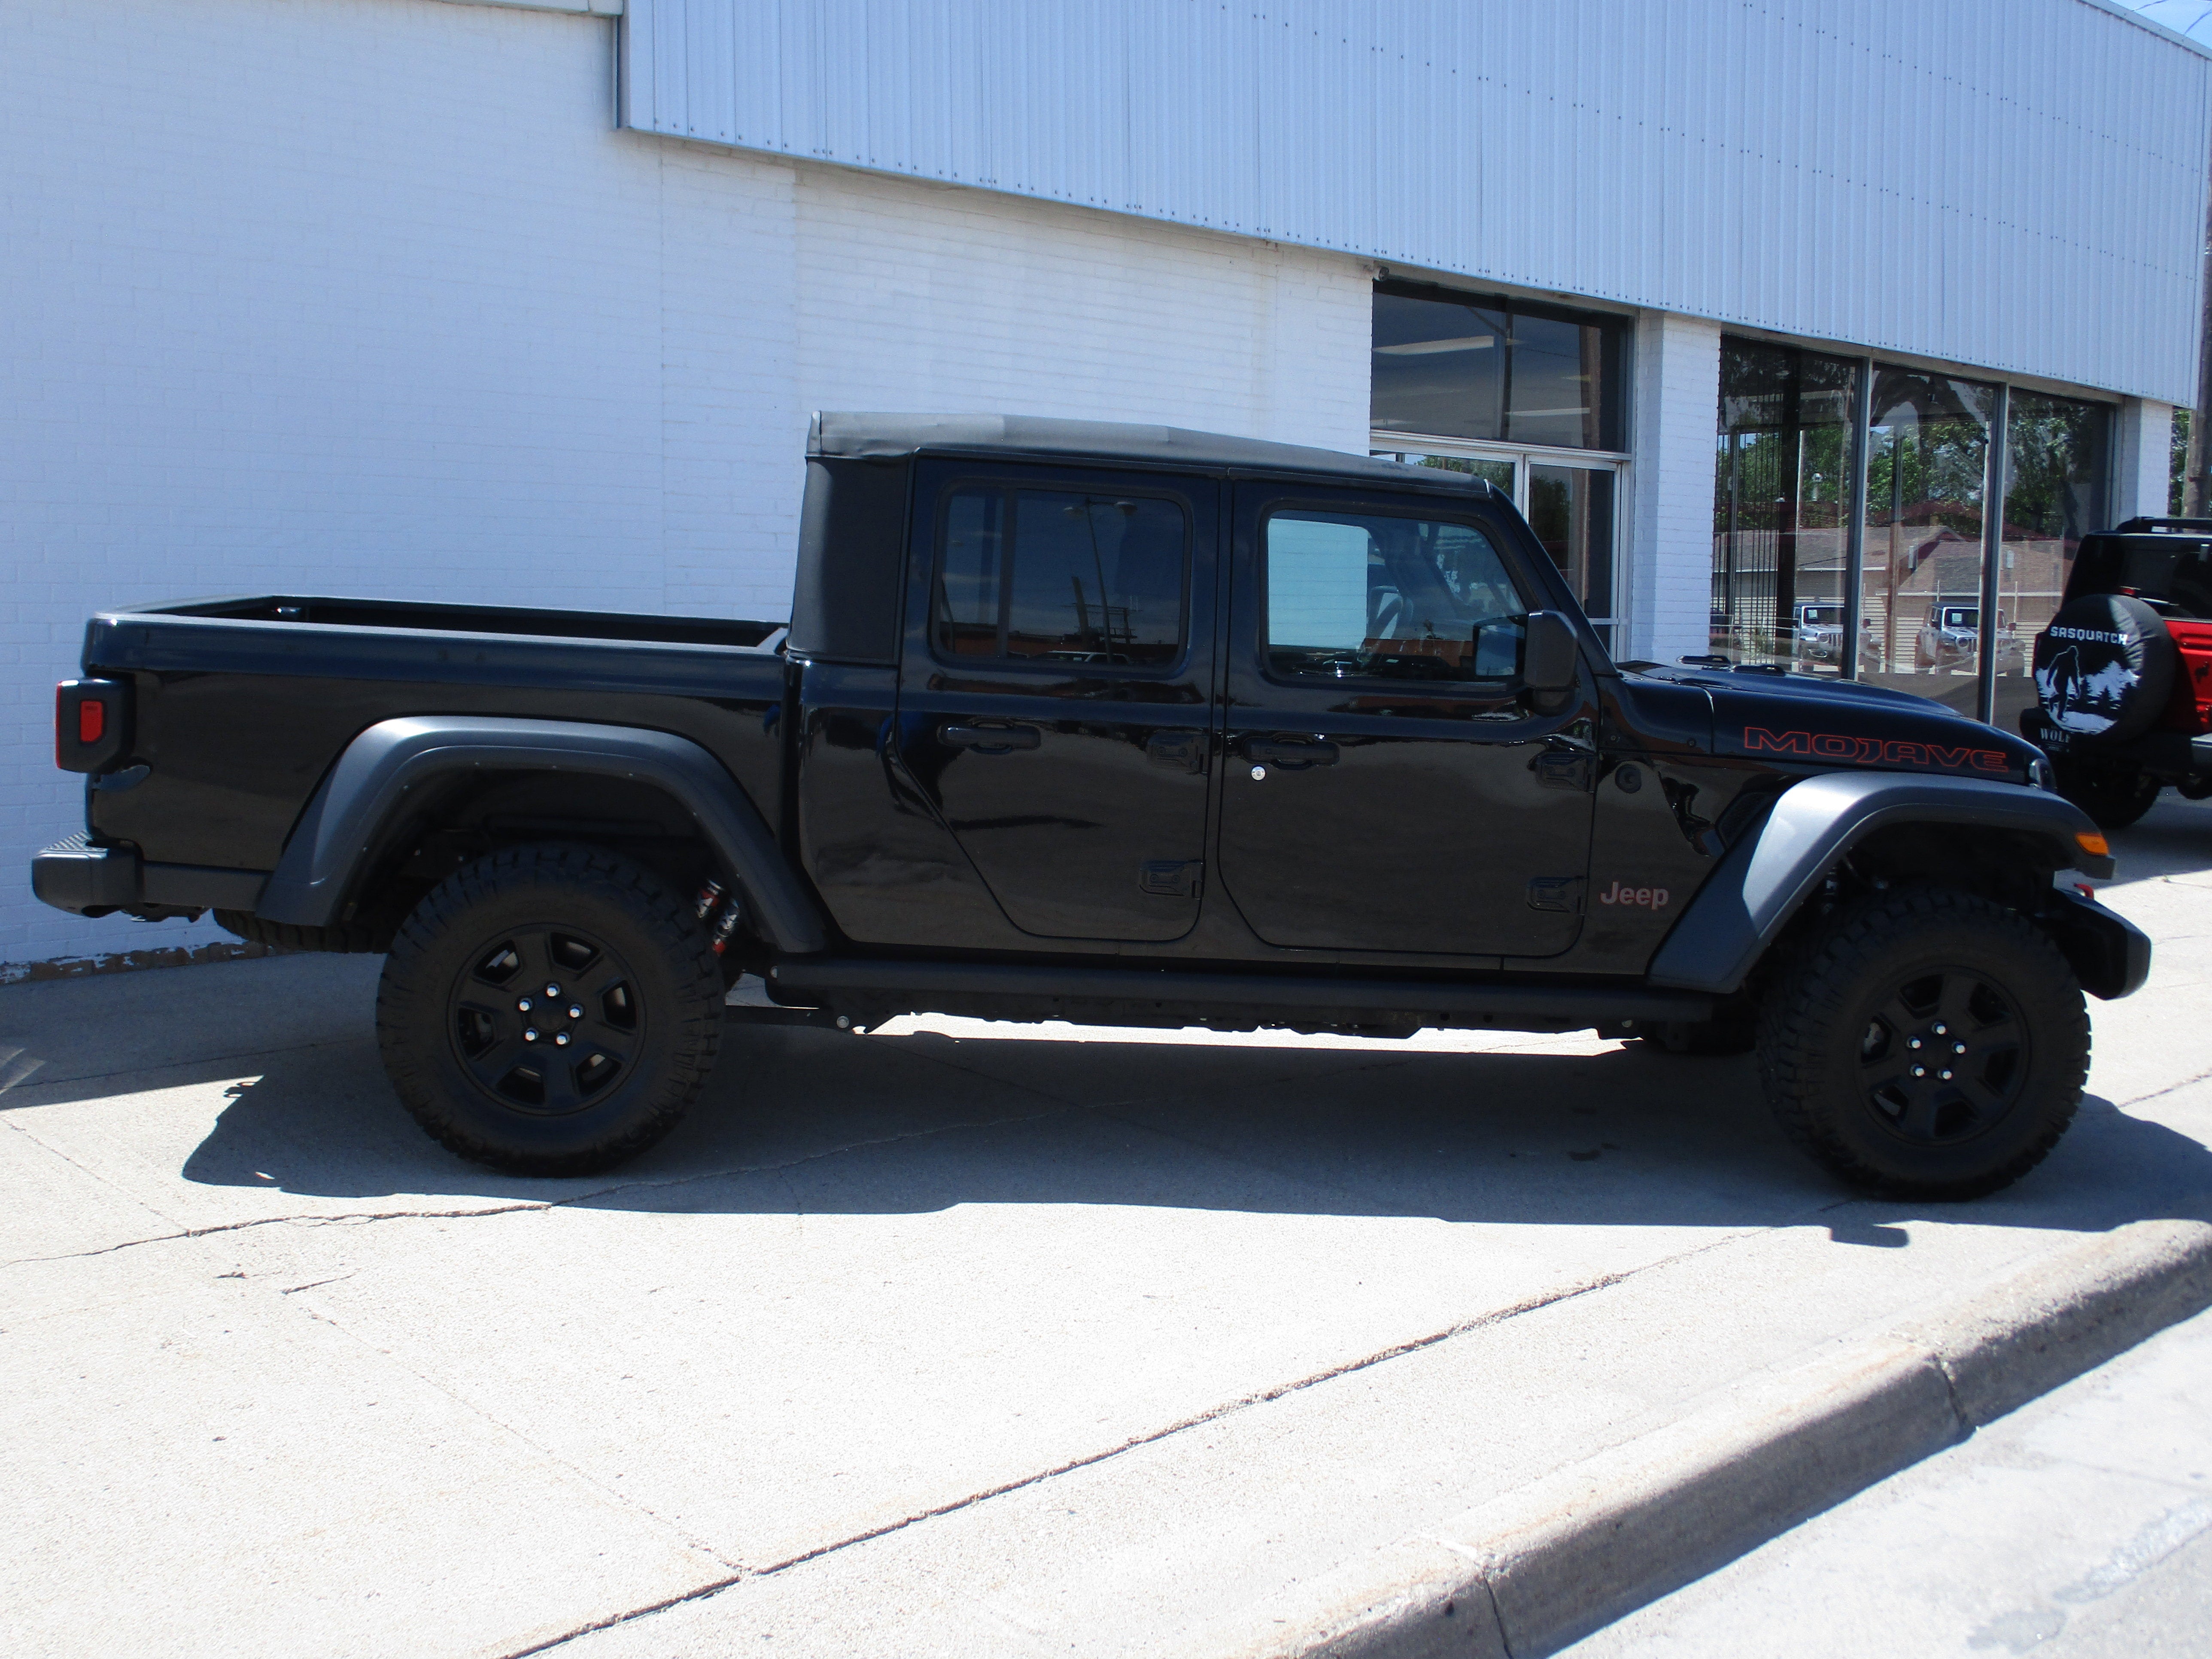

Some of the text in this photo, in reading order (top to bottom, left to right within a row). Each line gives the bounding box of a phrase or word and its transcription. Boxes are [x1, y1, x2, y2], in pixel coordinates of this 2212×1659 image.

[2050, 626, 2128, 645] SASQUATCH
[1744, 726, 2009, 772] MOJAVE
[1600, 881, 1669, 910] Jeep
